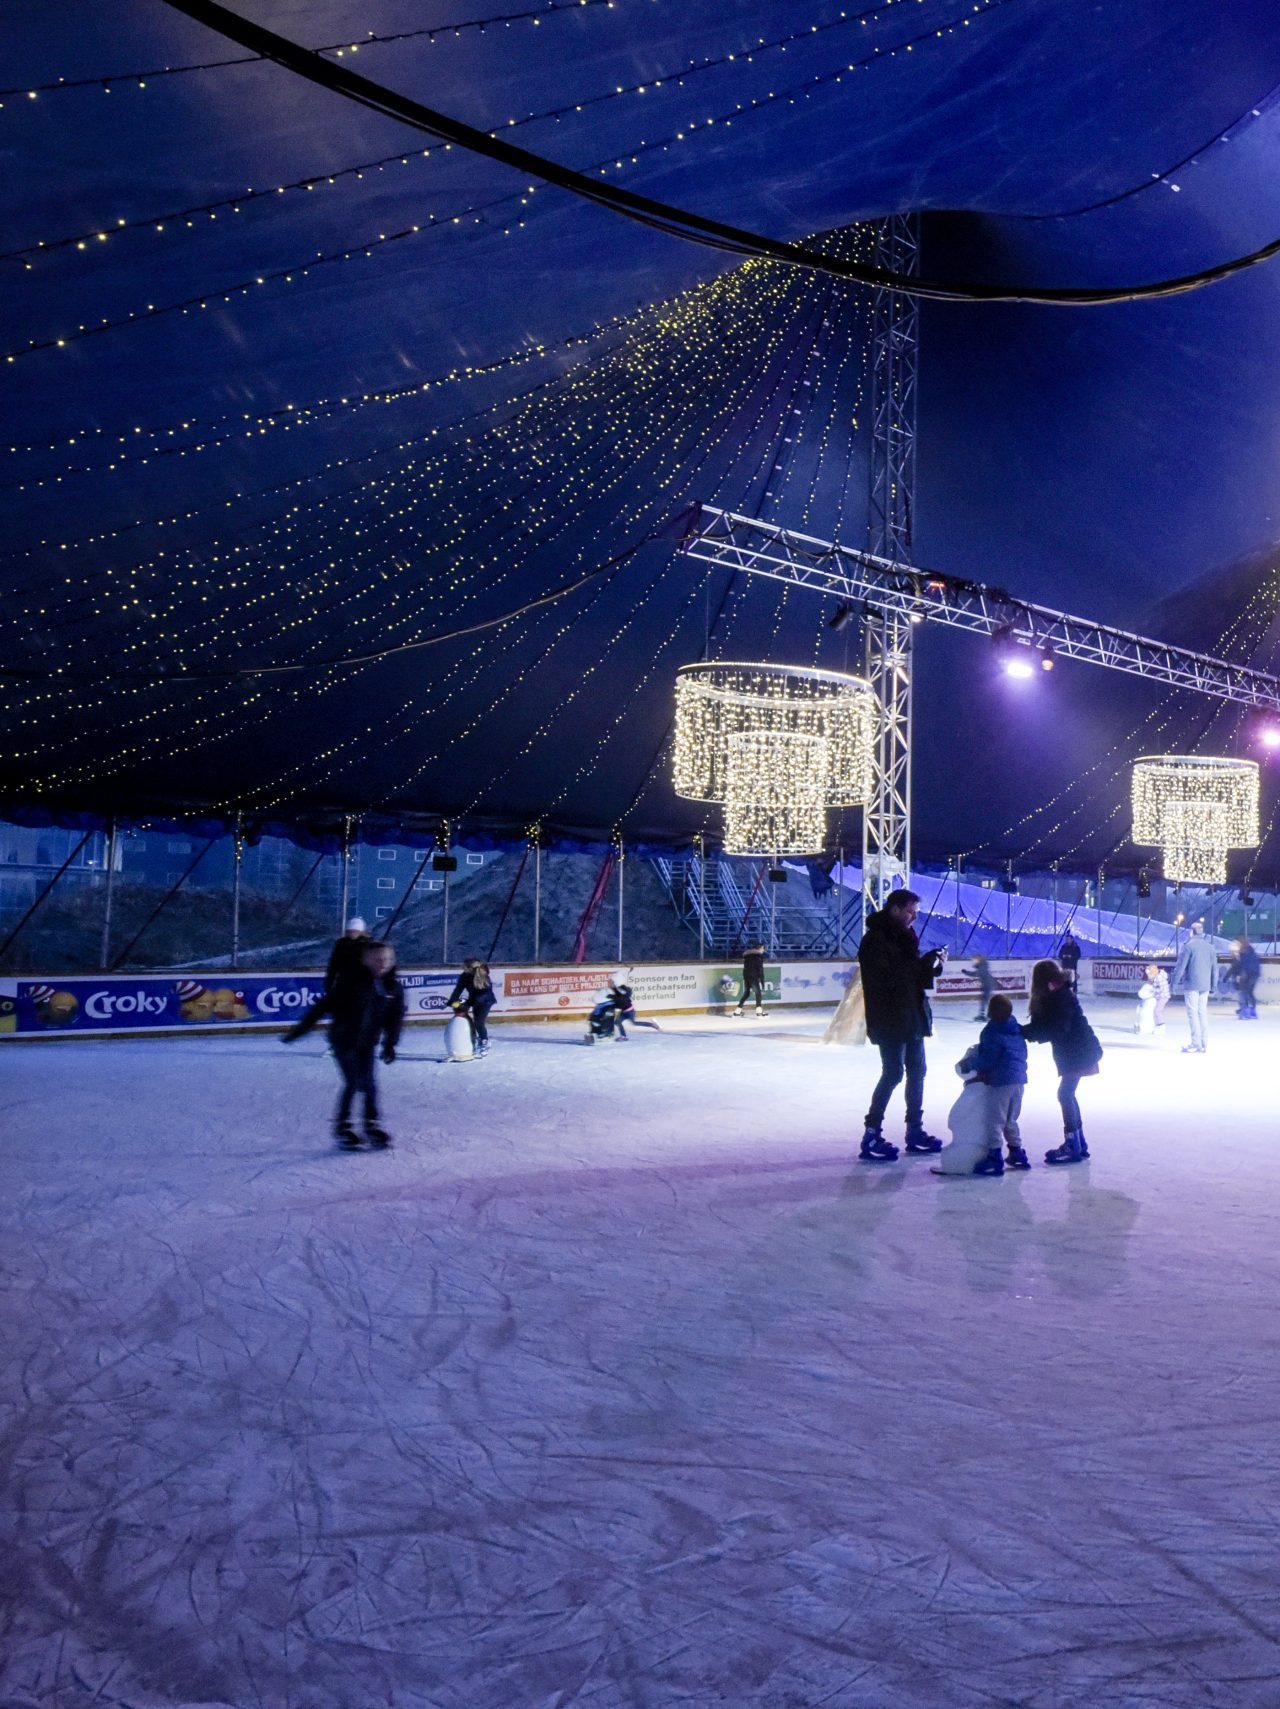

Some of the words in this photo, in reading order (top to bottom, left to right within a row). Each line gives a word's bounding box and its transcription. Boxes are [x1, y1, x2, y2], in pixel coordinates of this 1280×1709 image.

[1093, 964, 1144, 979] REMONDIS
[628, 975, 666, 984] Sponsor
[647, 982, 697, 991] schaatsend
[631, 991, 676, 1001] Nederland
[85, 990, 168, 1019] Croky
